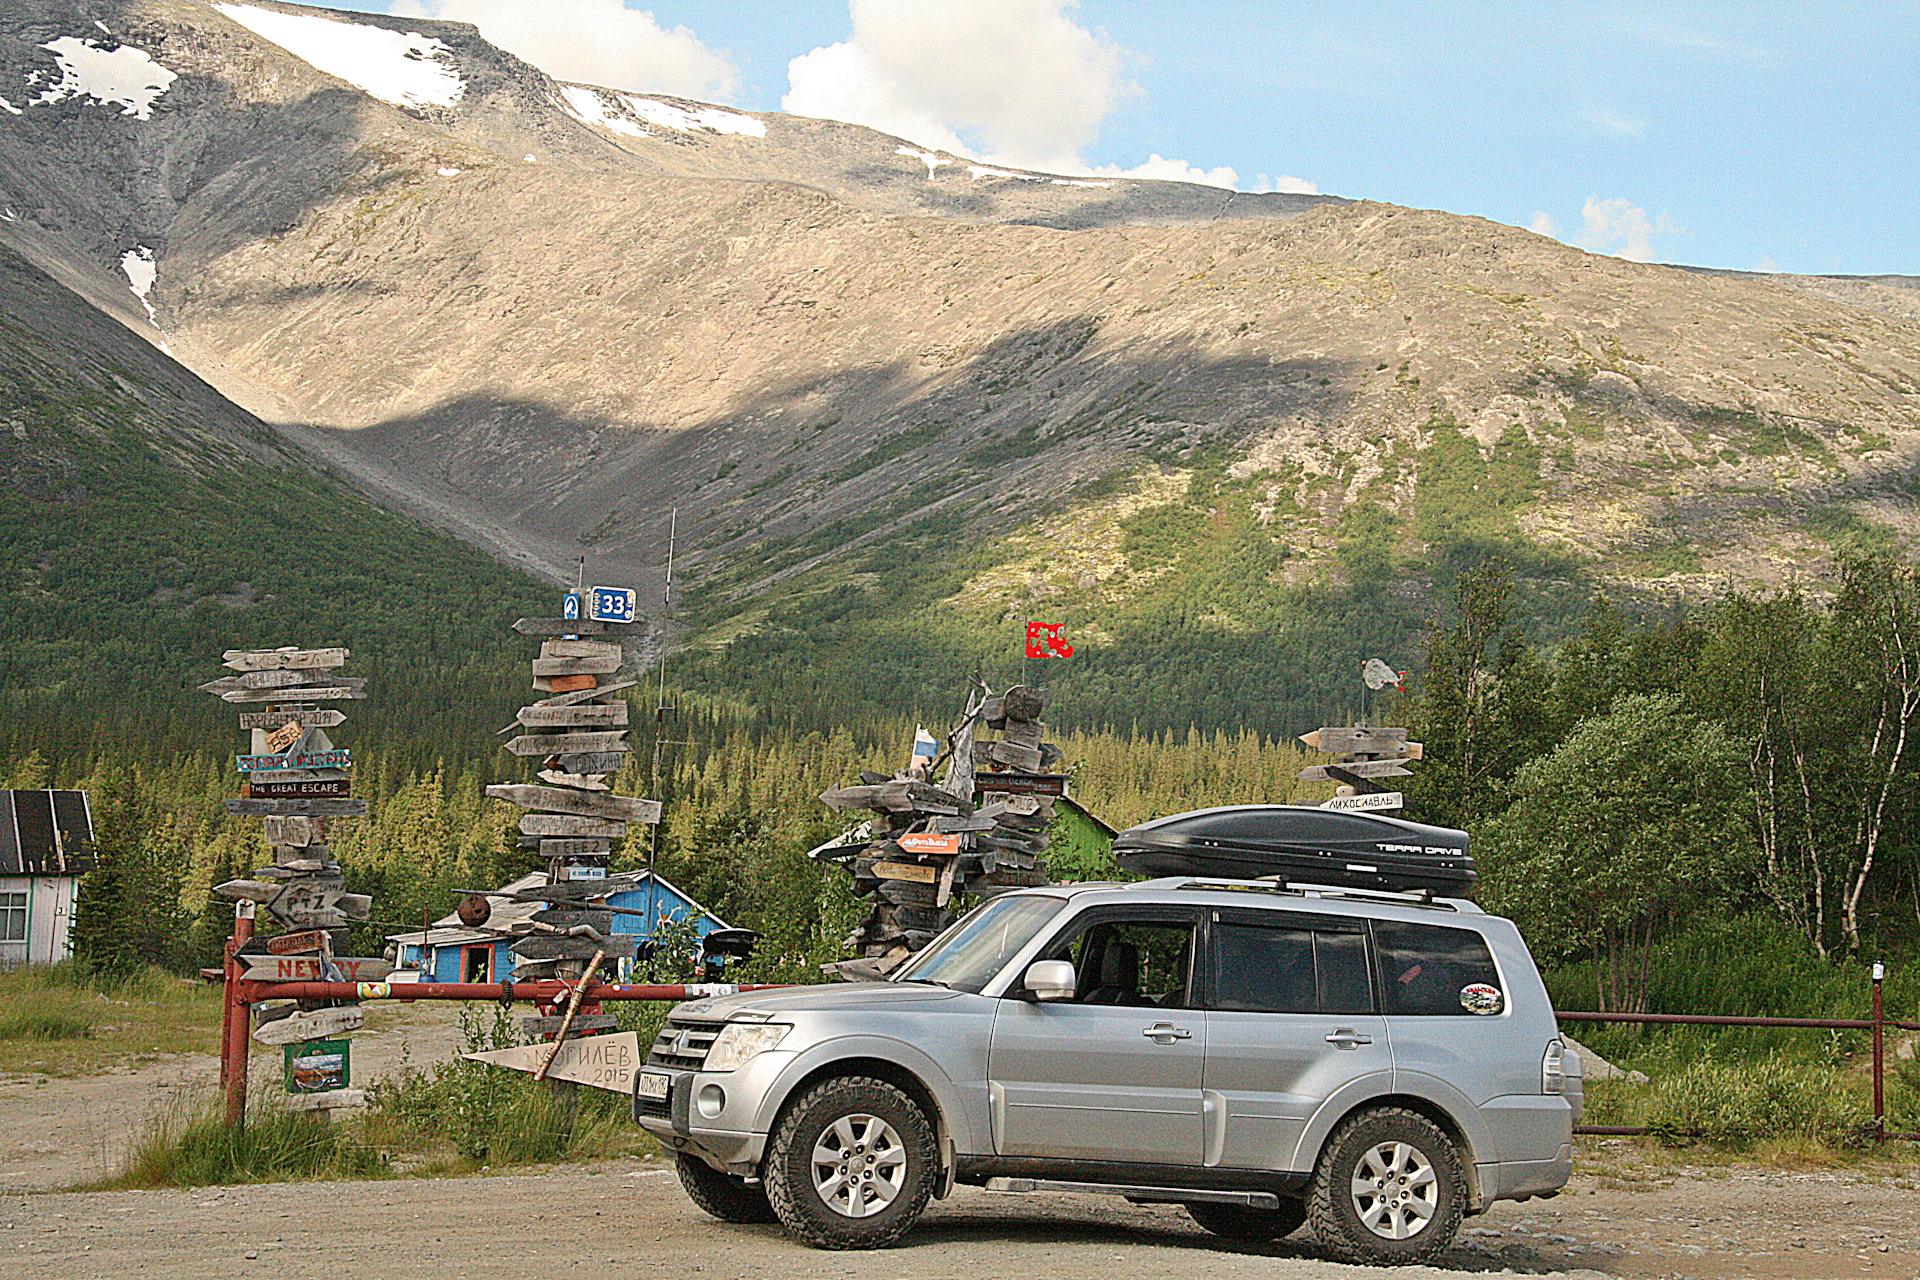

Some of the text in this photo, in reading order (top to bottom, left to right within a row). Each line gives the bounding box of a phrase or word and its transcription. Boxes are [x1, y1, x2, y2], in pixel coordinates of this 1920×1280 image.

[601, 595, 625, 614] 33
[251, 783, 339, 793] THE GREAT ESCAPE
[1328, 796, 1394, 809] ЛИХОСЛАВЛЬ
[1376, 843, 1462, 855] TERRA DRIVE
[594, 1068, 629, 1083] 2015
